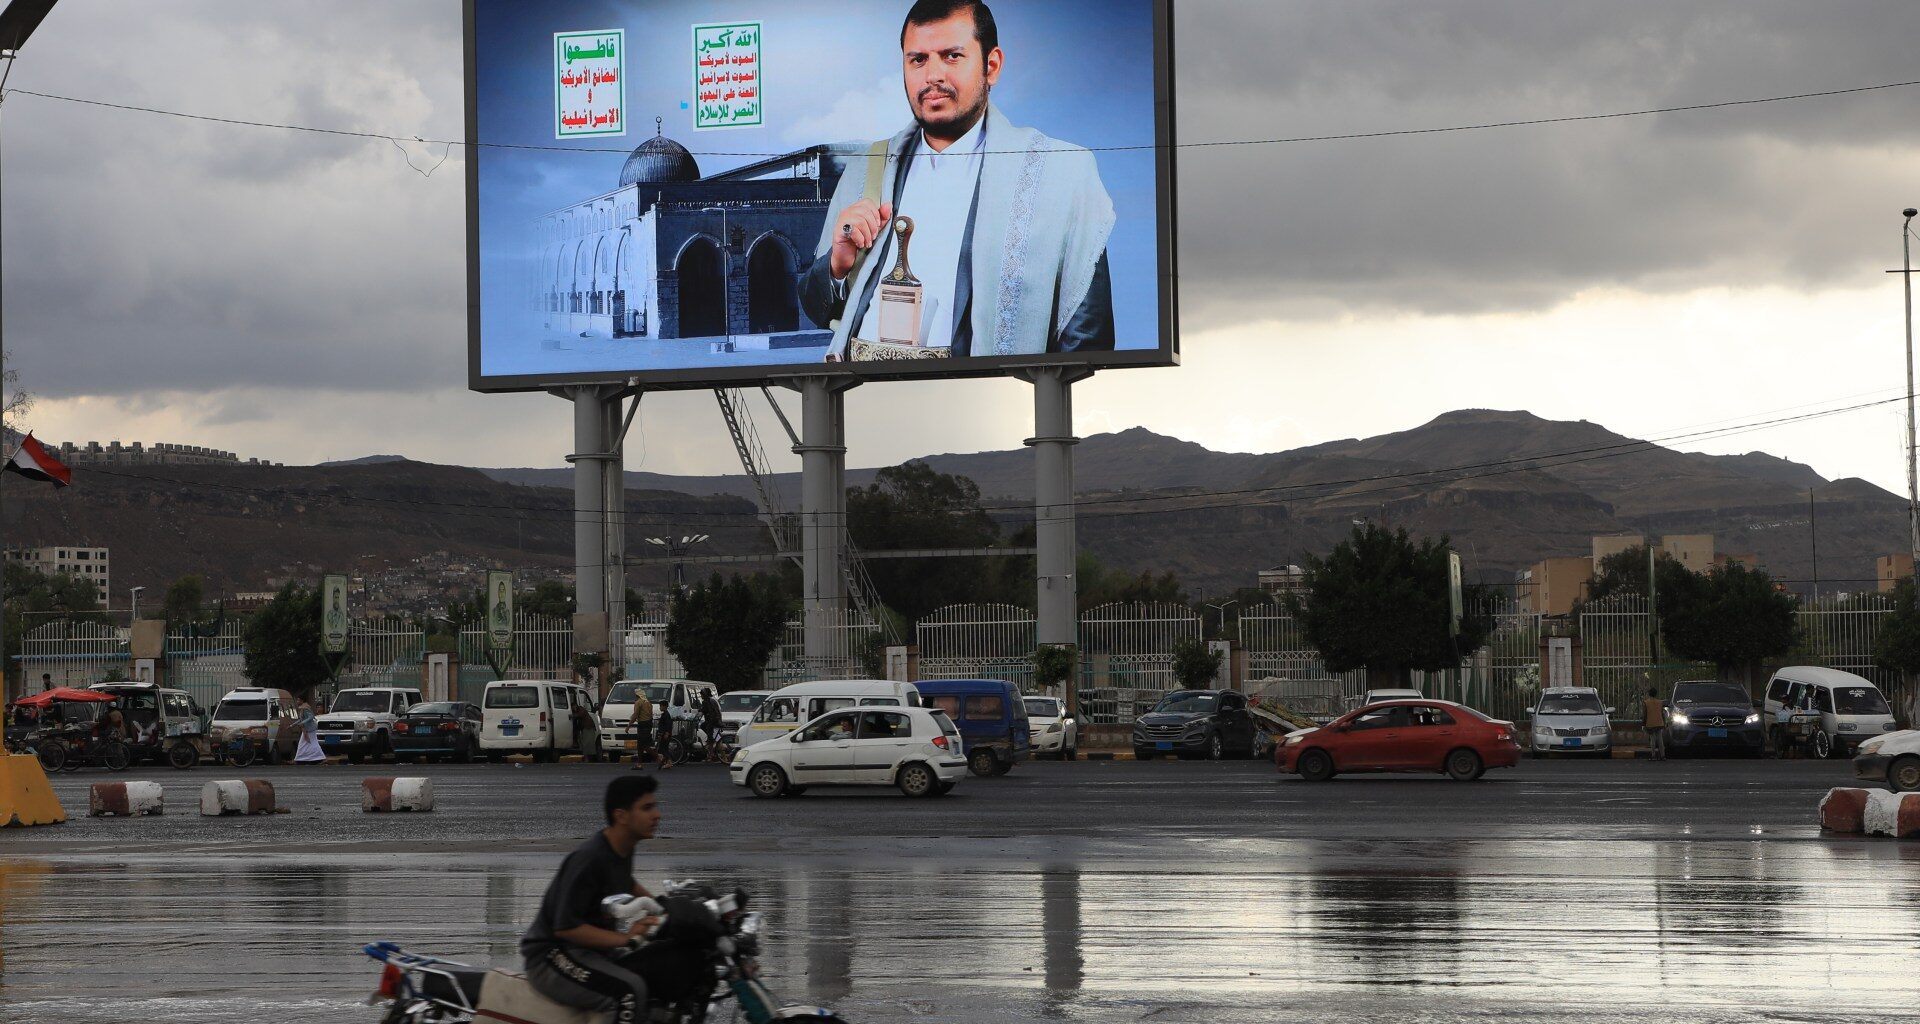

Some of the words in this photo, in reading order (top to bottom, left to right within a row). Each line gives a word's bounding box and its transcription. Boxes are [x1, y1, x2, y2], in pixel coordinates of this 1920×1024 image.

[699, 29, 734, 53] أكبر
[735, 30, 757, 47] الله
[732, 52, 757, 66] الموت
[561, 66, 591, 88] الأمريكية
[593, 67, 619, 87] البضائع
[732, 70, 757, 83] الموت
[587, 88, 593, 103] و
[699, 88, 721, 102] اليهود
[723, 88, 735, 101] على
[738, 87, 758, 98] اللعنة
[562, 108, 619, 129] الإسرائيلية
[699, 104, 729, 123] للإسلام
[731, 101, 758, 121] النصر
